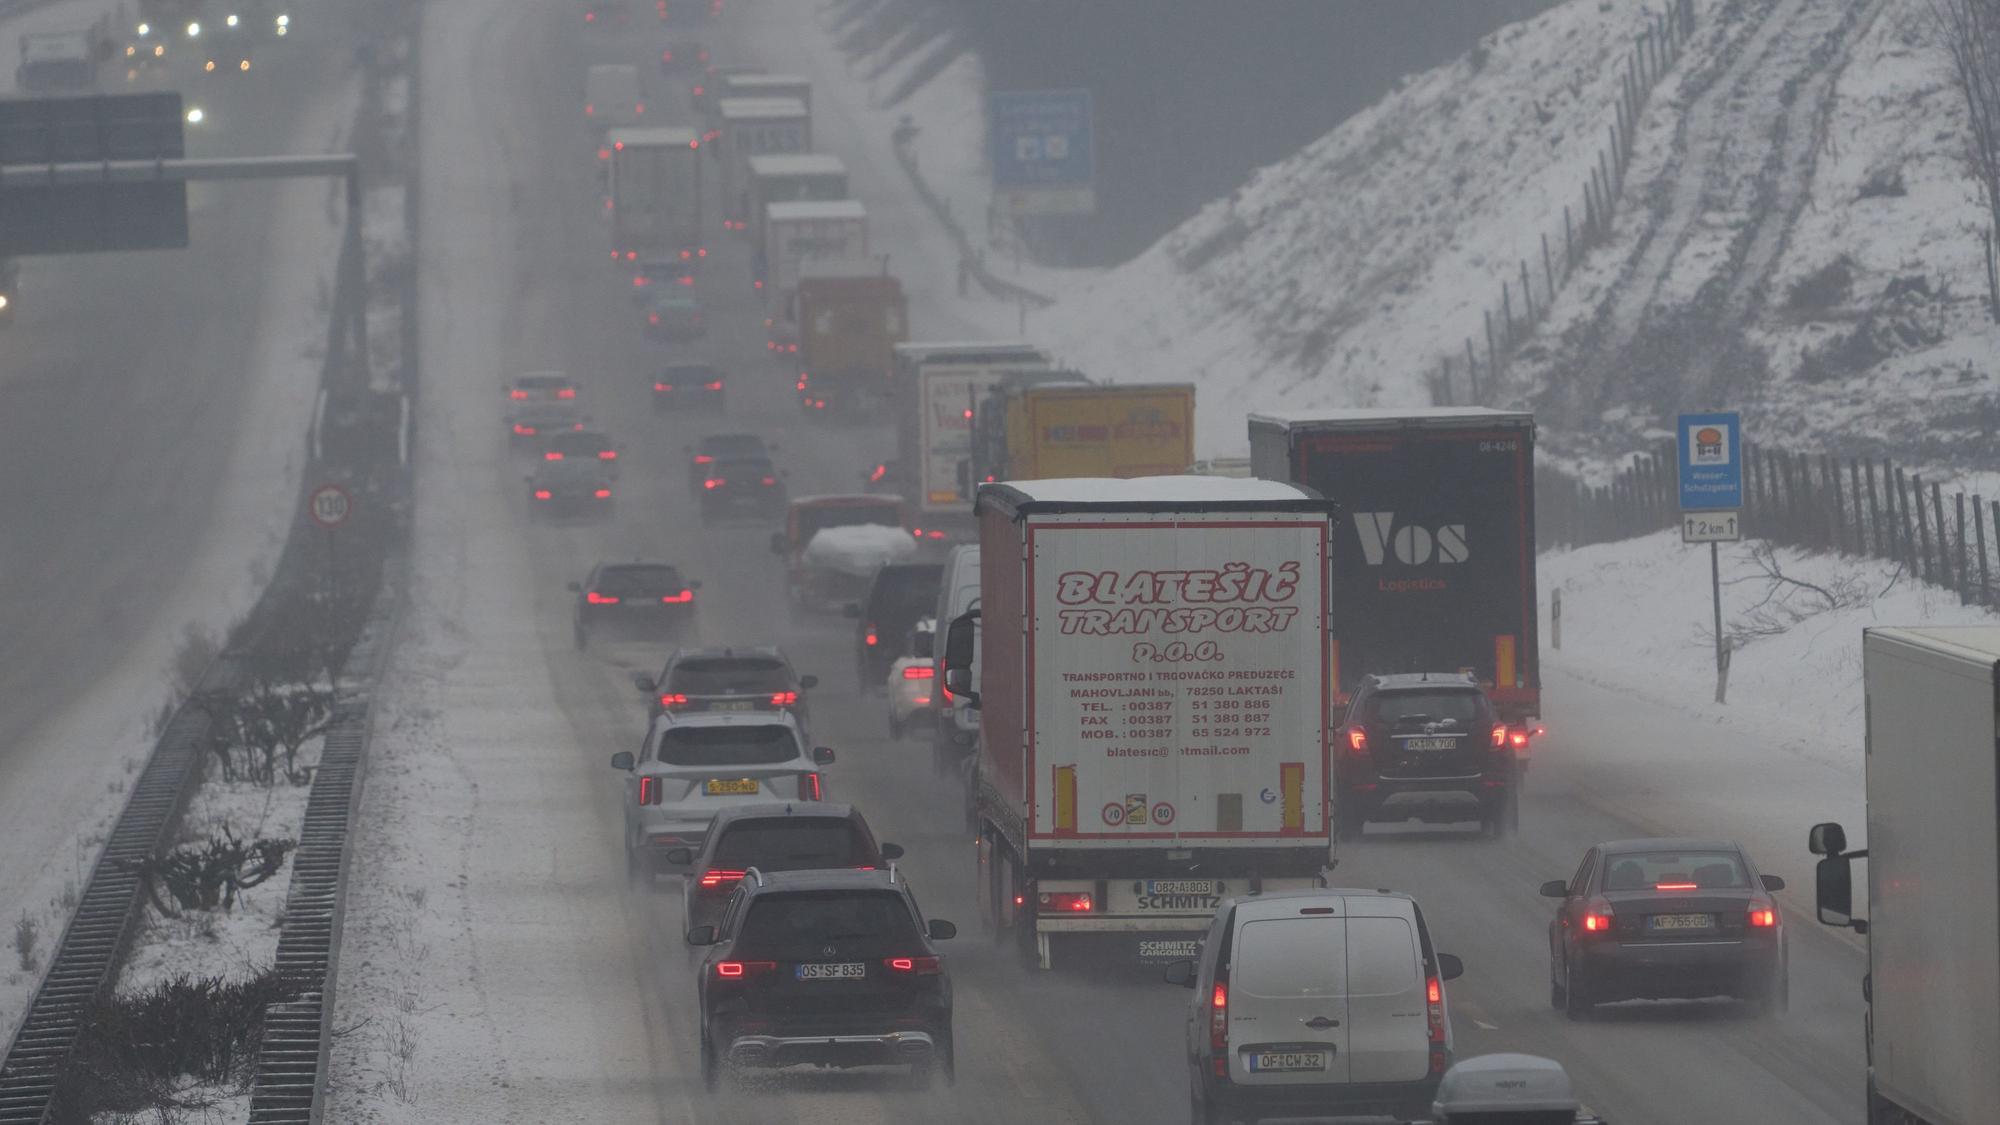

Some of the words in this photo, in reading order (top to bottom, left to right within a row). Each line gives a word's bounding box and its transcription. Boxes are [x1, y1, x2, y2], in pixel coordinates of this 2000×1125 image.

[1698, 521, 1707, 535] 2
[1709, 523, 1724, 535] km
[1352, 511, 1469, 566] Vos
[1057, 561, 1300, 605] BLATEŠIĆ
[1378, 577, 1447, 592] Logistics
[1059, 606, 1299, 636] TRANSPORT
[1062, 672, 1146, 682] TRANSPORTNO
[1149, 672, 1153, 681] I
[1070, 687, 1155, 698] MAHOVLJANI
[1186, 687, 1224, 696] 78250
[1081, 702, 1113, 712] TEL.
[1192, 701, 1208, 710] 51
[1214, 700, 1240, 710] 380
[1244, 700, 1271, 709] 886
[1081, 716, 1109, 725] FAX
[1192, 714, 1208, 724] 51
[1214, 714, 1240, 723] 380
[1244, 713, 1270, 723] 887
[1081, 730, 1119, 739] MOB.
[1192, 728, 1209, 738] 65
[1214, 728, 1240, 737] 524
[1244, 727, 1271, 737] 972
[1157, 808, 1170, 818] 80
[1138, 895, 1221, 909] SCHMITZ
[1139, 941, 1196, 950] SCHMITZ
[1139, 949, 1196, 957] CARGOBULL
[802, 965, 817, 977] OS
[825, 965, 839, 976] SF
[842, 964, 863, 976] 835
[1262, 1055, 1278, 1067] OF
[1286, 1055, 1301, 1067] CW
[1304, 1054, 1320, 1066] 32
